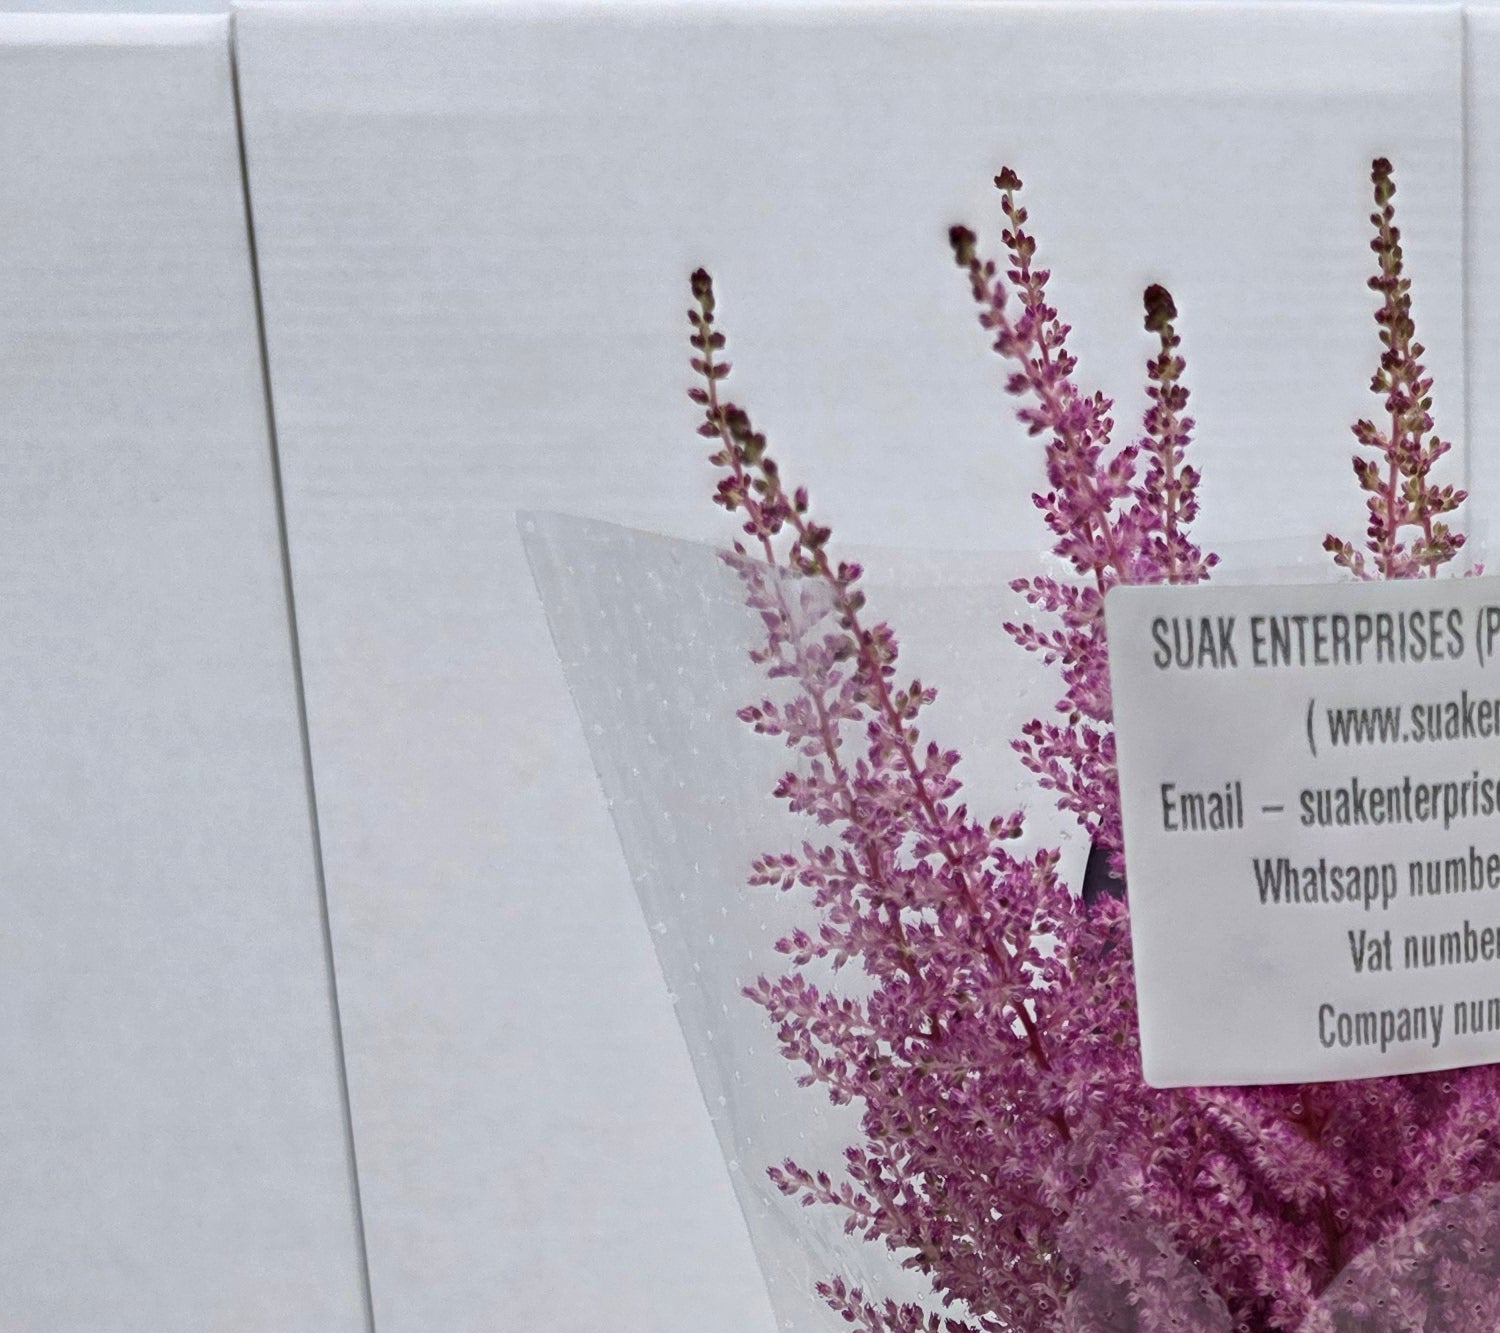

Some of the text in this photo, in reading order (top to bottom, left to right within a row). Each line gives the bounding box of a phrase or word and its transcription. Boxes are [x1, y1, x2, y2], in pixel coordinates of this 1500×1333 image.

[1152, 617, 1237, 670] SUAK
[1250, 608, 1464, 666] ENTERPRISES
[1160, 781, 1243, 831] Email
[1253, 858, 1396, 911] Whatsapp
[1348, 930, 1392, 972] Vat
[1318, 1003, 1443, 1053] Company
